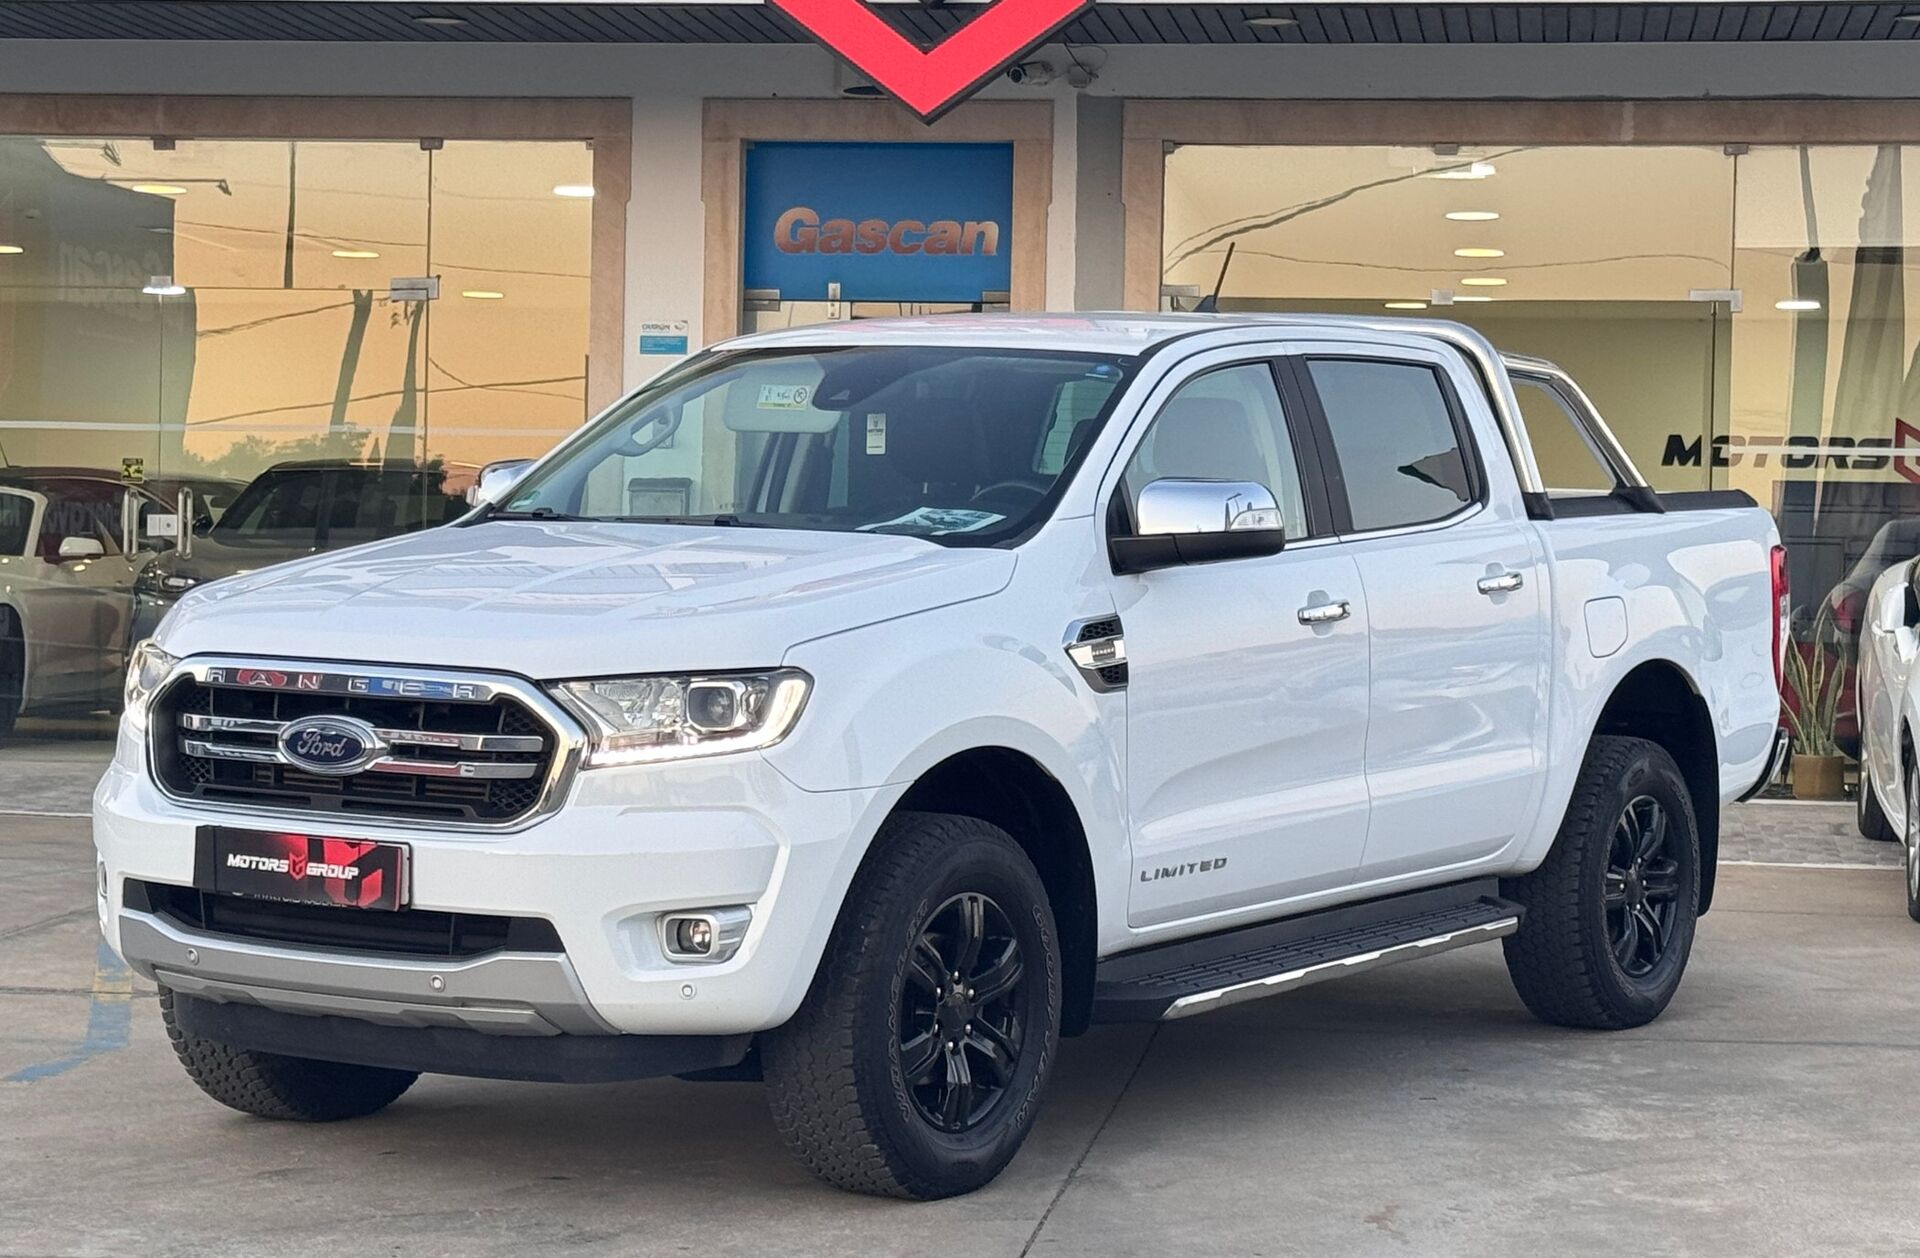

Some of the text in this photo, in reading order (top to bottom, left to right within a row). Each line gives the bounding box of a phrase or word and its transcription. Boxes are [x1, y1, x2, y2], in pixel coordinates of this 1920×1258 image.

[774, 206, 999, 256] Gascan
[1661, 434, 1892, 470] MOTORS
[206, 669, 478, 699] RANGER
[297, 728, 348, 758] Ford
[227, 853, 360, 880] MOTORS GROUP
[1140, 857, 1228, 882] LIMITED
